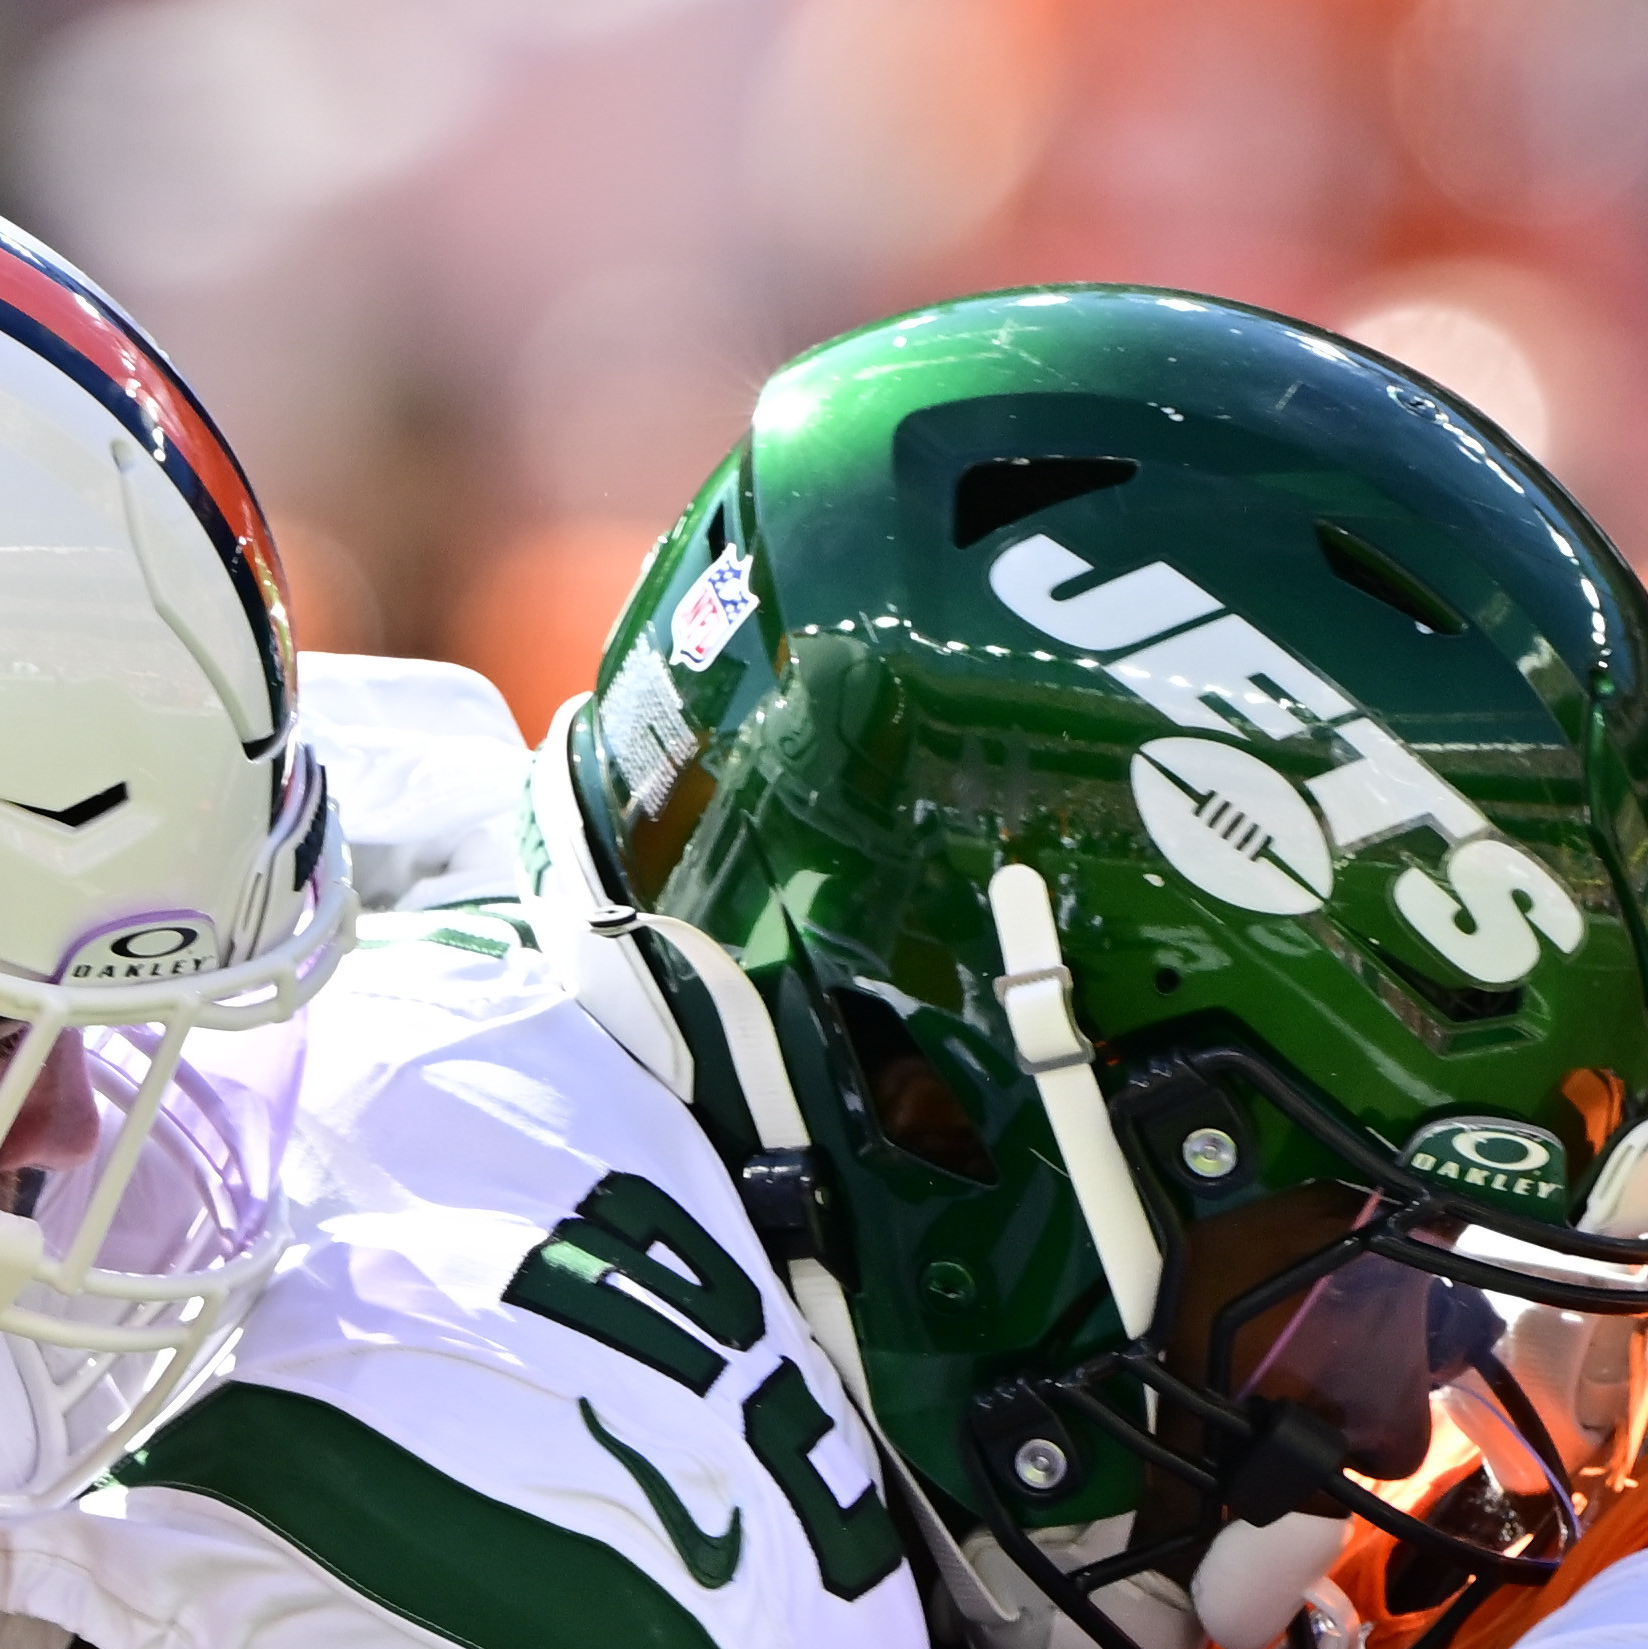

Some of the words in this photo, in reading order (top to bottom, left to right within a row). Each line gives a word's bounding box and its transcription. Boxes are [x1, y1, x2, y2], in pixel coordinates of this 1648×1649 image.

[989, 532, 1585, 985] JETS
[71, 956, 209, 979] OAKLEY
[1410, 1152, 1562, 1199] OAKLEY
